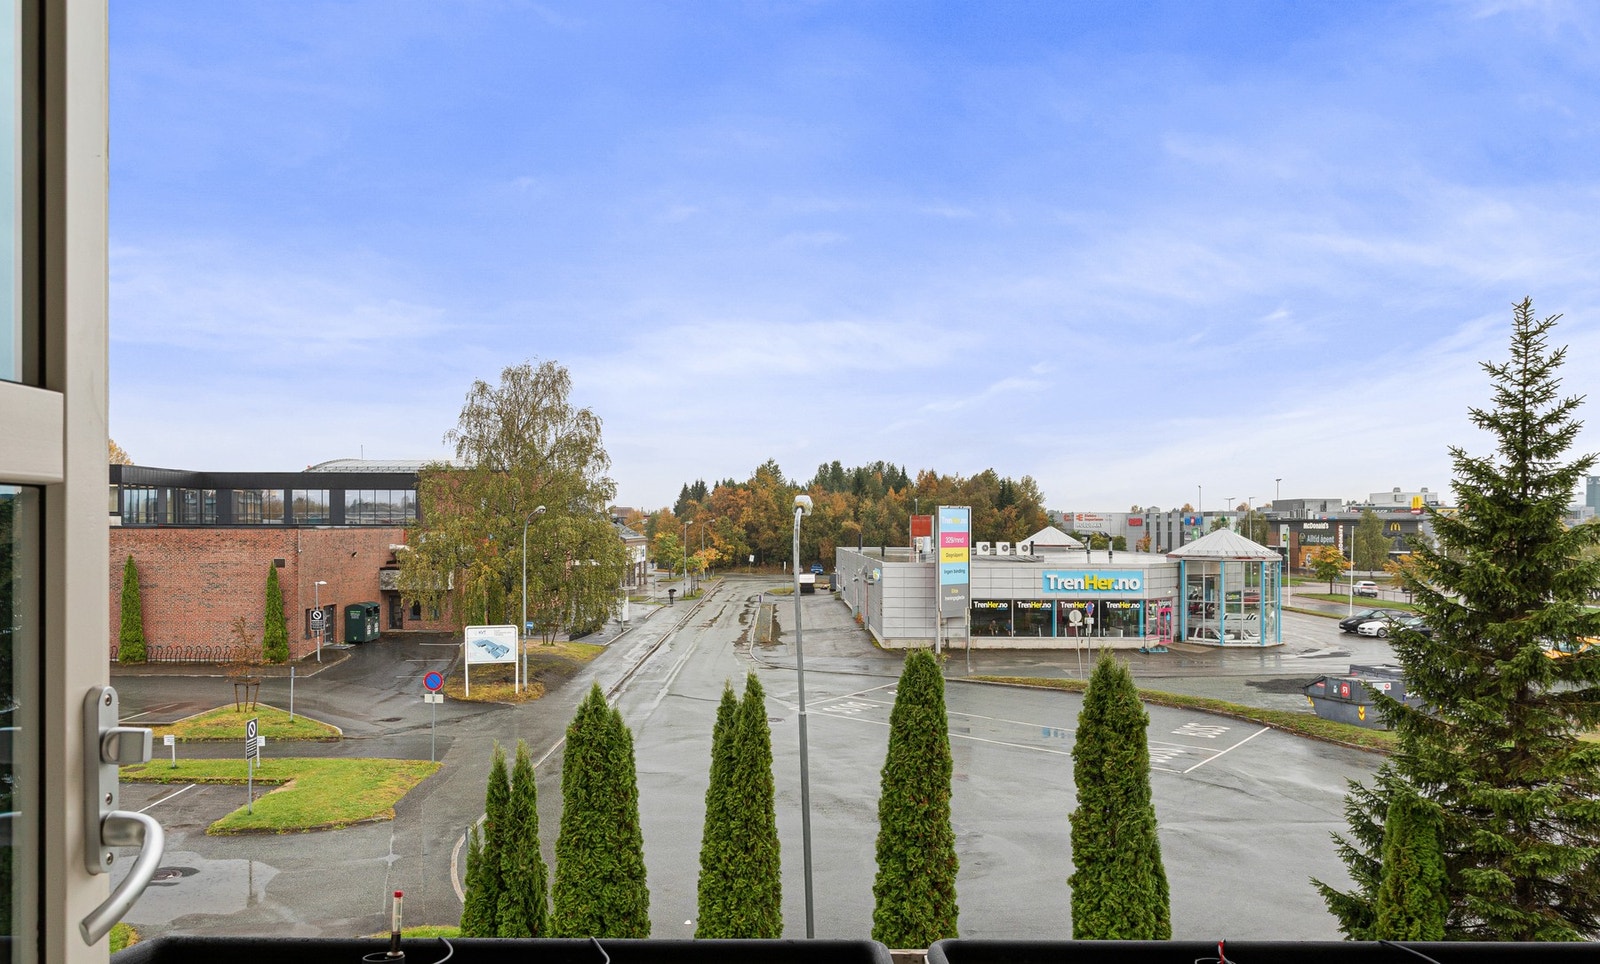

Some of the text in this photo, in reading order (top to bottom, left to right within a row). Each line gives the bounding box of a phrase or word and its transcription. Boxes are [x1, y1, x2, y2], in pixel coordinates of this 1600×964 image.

[1046, 574, 1141, 590] TrenHer.no
[973, 601, 1009, 609] TrenHer.no
[1017, 601, 1052, 609] TrenHer.no
[1106, 601, 1140, 609] TrenHer.no
